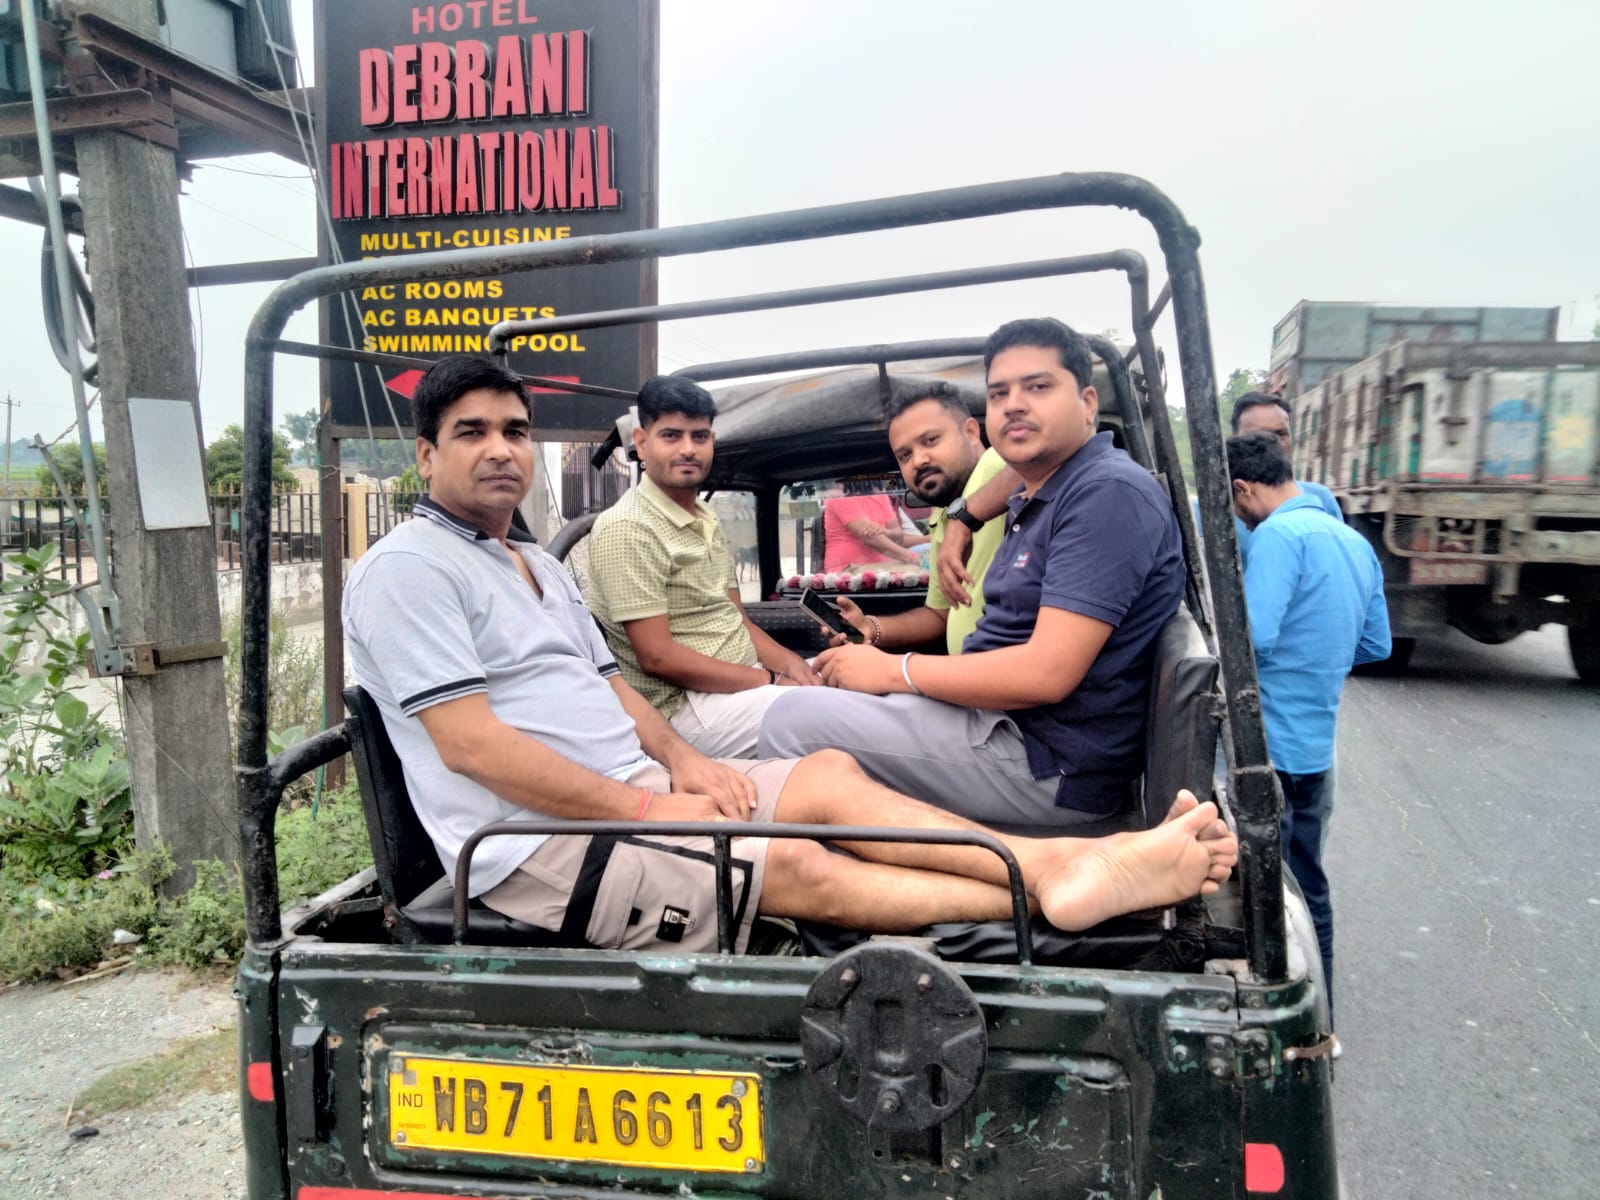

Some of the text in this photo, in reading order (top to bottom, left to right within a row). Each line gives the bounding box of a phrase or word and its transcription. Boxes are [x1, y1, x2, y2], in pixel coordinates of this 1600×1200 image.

[411, 0, 538, 34] HOTEL
[359, 29, 588, 129] DEBRANI
[331, 125, 620, 219] INTERNATIONAL
[361, 226, 571, 251] MULTI-CUISINE
[362, 280, 503, 300] AC ROOMS
[363, 306, 555, 327] AC BANQUETS
[511, 333, 586, 352] POOL
[397, 1092, 423, 1108] IND
